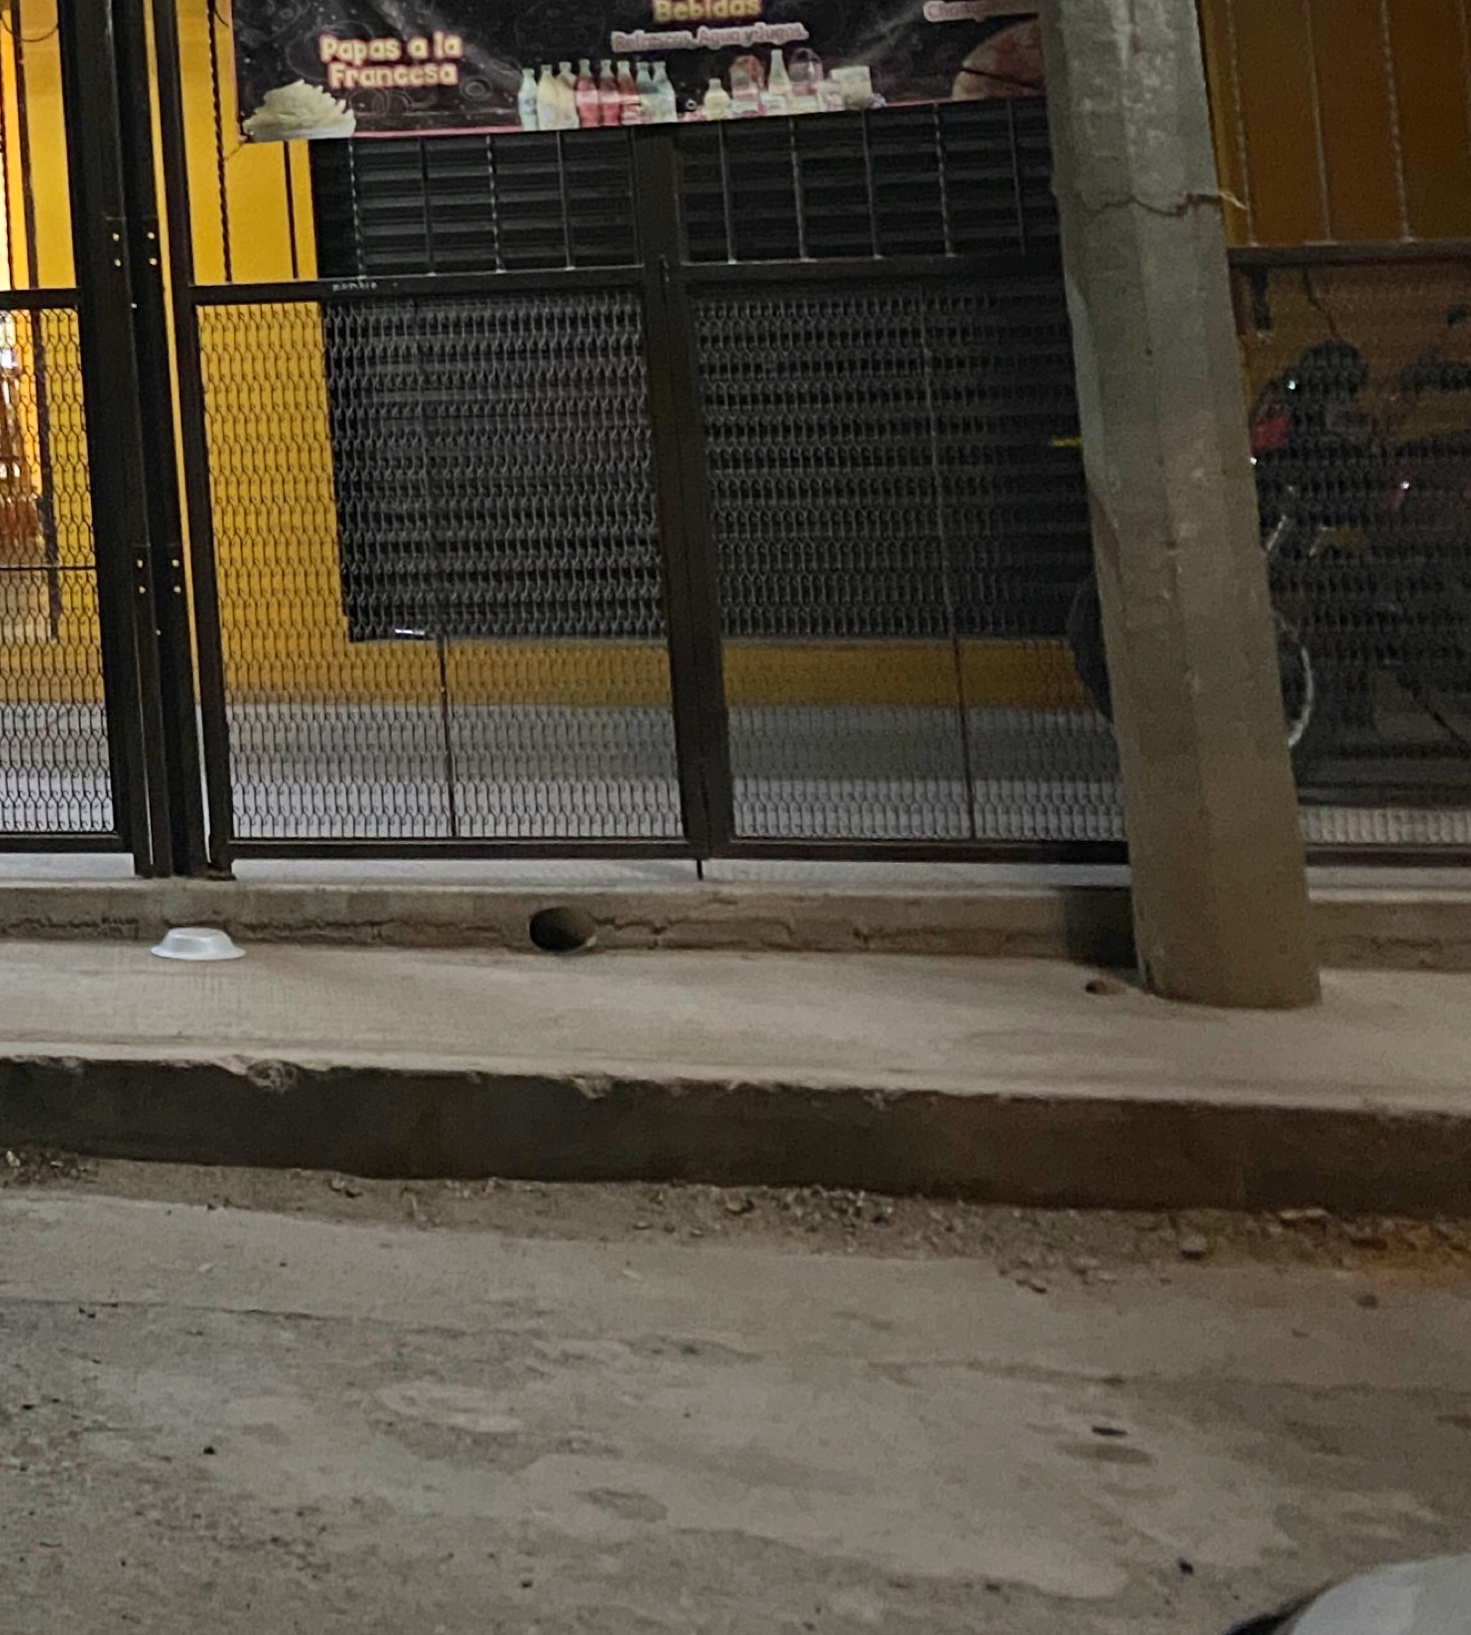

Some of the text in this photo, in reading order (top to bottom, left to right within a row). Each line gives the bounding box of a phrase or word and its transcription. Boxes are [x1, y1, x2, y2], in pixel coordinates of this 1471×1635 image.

[318, 29, 464, 66] Papas a la
[327, 62, 459, 89] Francesa
